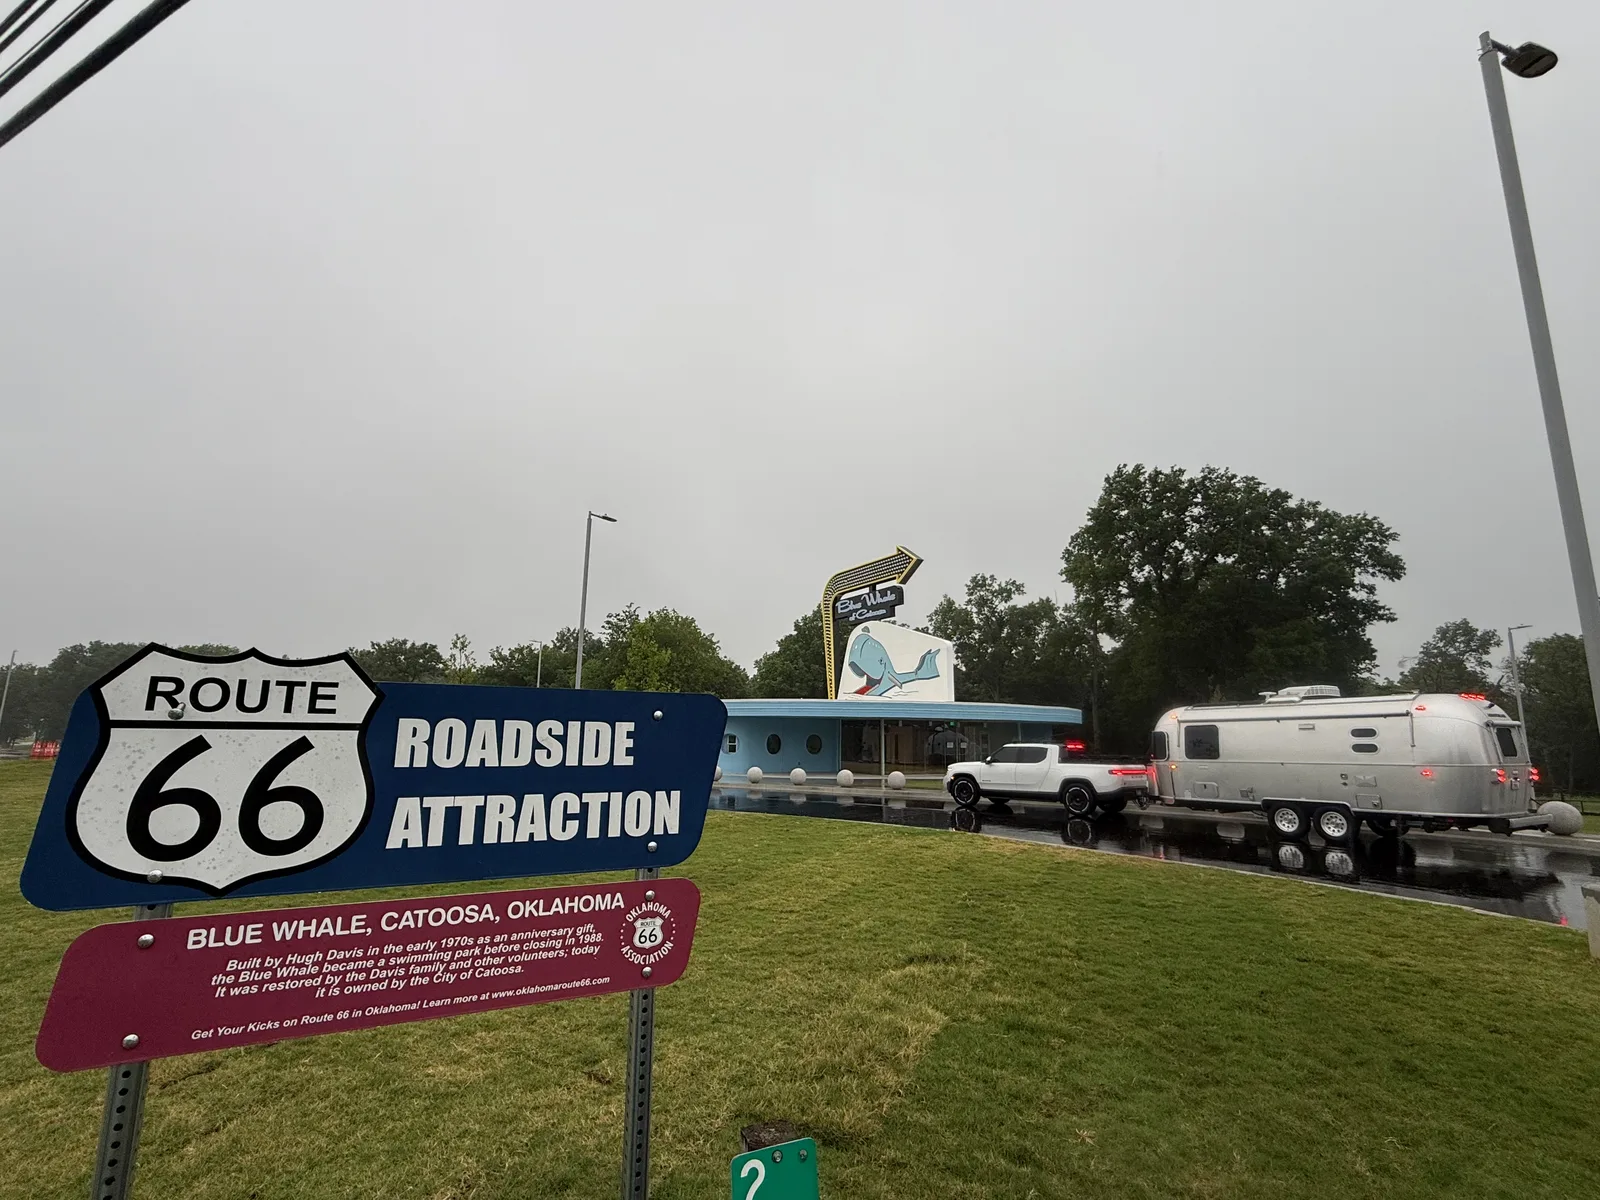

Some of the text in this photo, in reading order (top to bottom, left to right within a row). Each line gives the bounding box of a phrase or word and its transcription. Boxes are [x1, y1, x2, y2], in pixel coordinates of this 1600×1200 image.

[144, 676, 339, 714] ROUTE
[394, 718, 635, 768] ROADSIDE
[126, 734, 324, 862] 66
[385, 790, 680, 850] ATTRACTION
[187, 892, 625, 950] BLUE WHALE, CATOOSA, OKLAHOMA
[626, 902, 671, 922] OKLAHOMA
[638, 928, 657, 944] 66
[211, 974, 234, 985] the
[239, 970, 272, 982] Blue
[276, 964, 319, 978] Whale
[322, 960, 374, 973] became
[389, 951, 452, 965] swimming
[454, 946, 481, 959] park
[484, 943, 520, 954] before
[523, 939, 562, 950] closing
[565, 936, 575, 945] in
[579, 933, 604, 944] 1988.
[215, 945, 600, 997] It was restored by the Davis family and other volunteers; today
[226, 923, 596, 971] Built by Hugh Davis in the early 1970s as an anniversary gift,
[620, 941, 674, 964] ASSOCIATION
[315, 965, 524, 998] it is owned by the City of Catoosa.
[191, 1028, 213, 1040] Get
[217, 1024, 245, 1037] Your
[247, 1020, 280, 1032] Kicks
[283, 1018, 298, 1028] on
[300, 1013, 333, 1025] Route
[337, 1010, 349, 1020] 66
[352, 1008, 362, 1018] in
[365, 1000, 421, 1016] Oklahoma!
[423, 998, 450, 1009] Learn
[453, 995, 477, 1005] more
[492, 976, 610, 999] www.oklahomaroute66.com
[740, 1159, 766, 1200] 2
